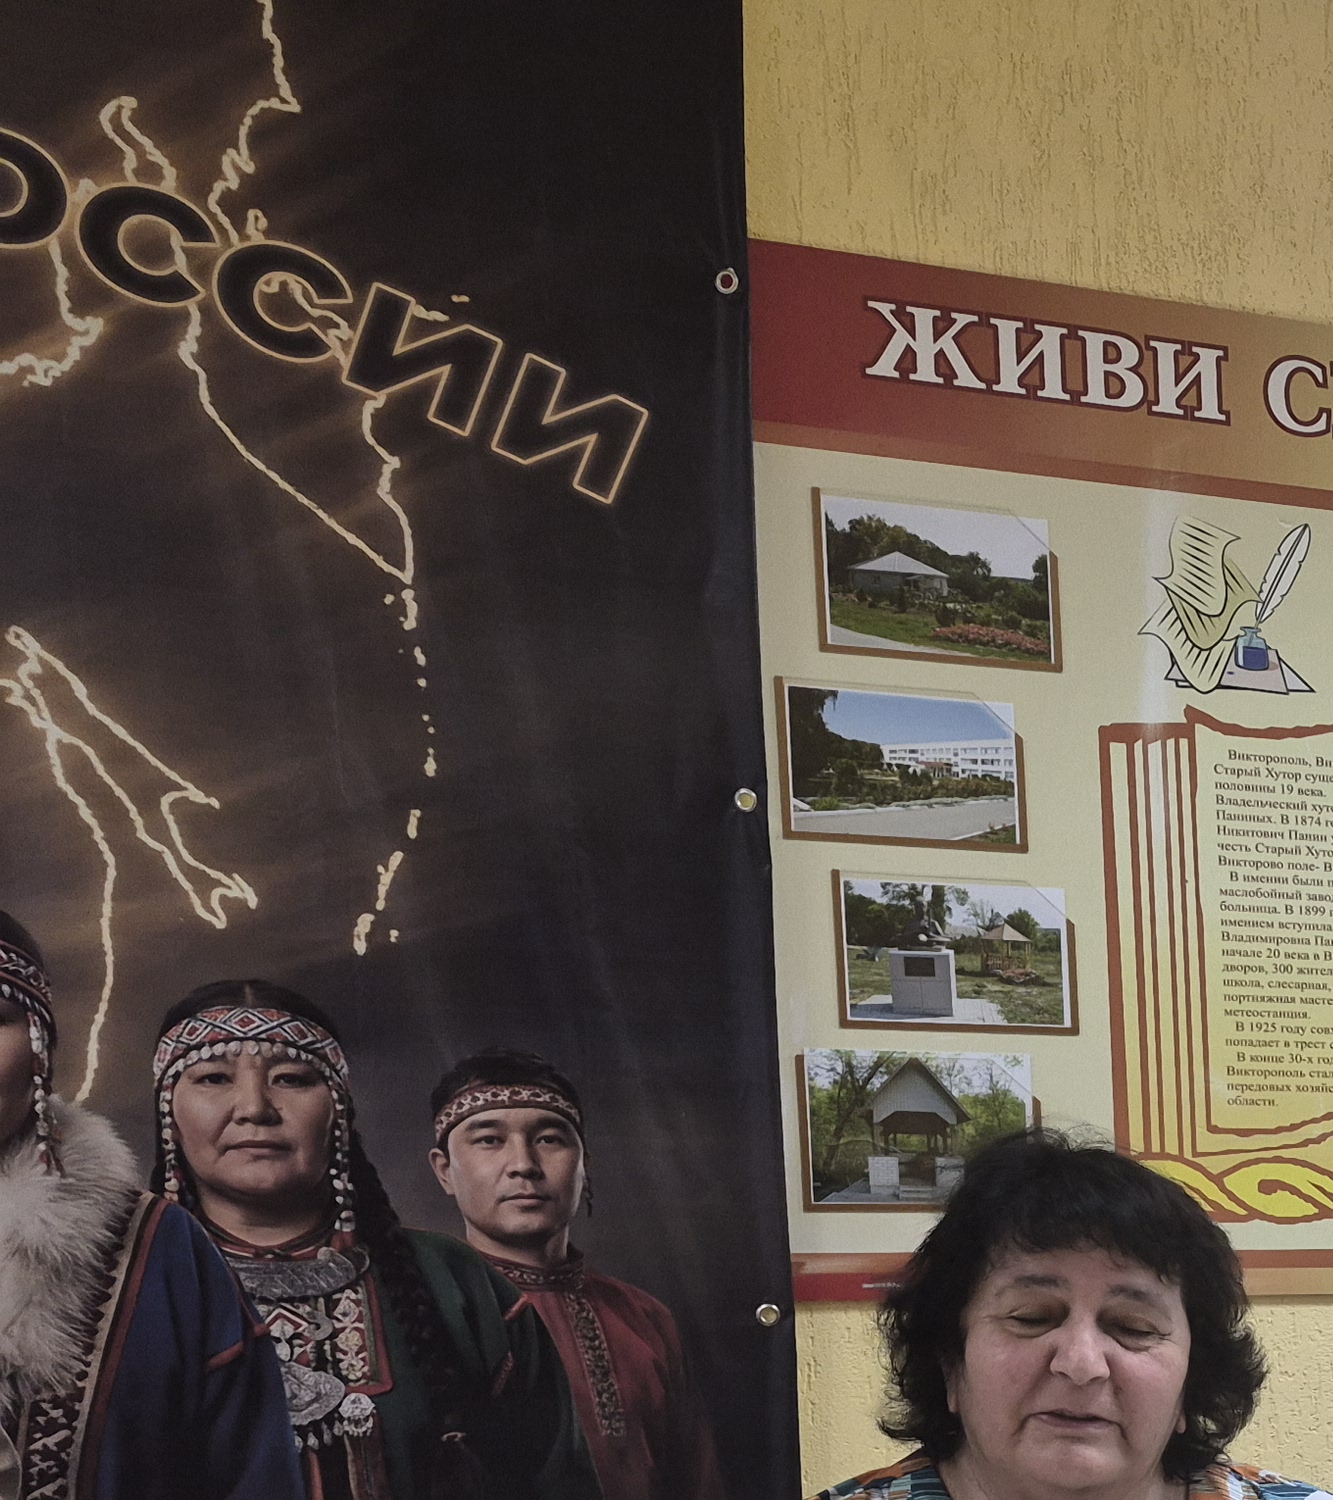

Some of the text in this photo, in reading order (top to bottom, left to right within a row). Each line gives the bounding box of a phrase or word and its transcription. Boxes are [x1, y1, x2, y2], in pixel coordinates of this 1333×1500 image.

[863, 296, 1230, 425] ЖИВИ
[1227, 749, 1312, 768] Викторополь,
[1213, 764, 1261, 780] Старый
[1264, 767, 1301, 784] Хутор
[1214, 781, 1327, 797] половины 19 века.
[1215, 793, 1307, 811] Владельческий
[1216, 843, 1251, 853] честь
[1254, 842, 1302, 858] Старый
[1217, 854, 1284, 871] Викторово
[1218, 887, 1302, 901] маслобойный
[1220, 918, 1274, 929] имением
[1221, 964, 1268, 976] дворов,
[1271, 963, 1293, 975] 300
[1222, 978, 1264, 990] школа,
[1267, 980, 1332, 993] слесарная,
[1222, 994, 1296, 1006] портняжная
[1223, 1008, 1311, 1022] метеостанция.
[1235, 1020, 1245, 1032] В
[1249, 1020, 1277, 1033] 1925
[1280, 1025, 1307, 1037] году
[1226, 1065, 1306, 1080] Викторополь
[1226, 1083, 1292, 1095] передовых
[1226, 1094, 1279, 1107] области.
